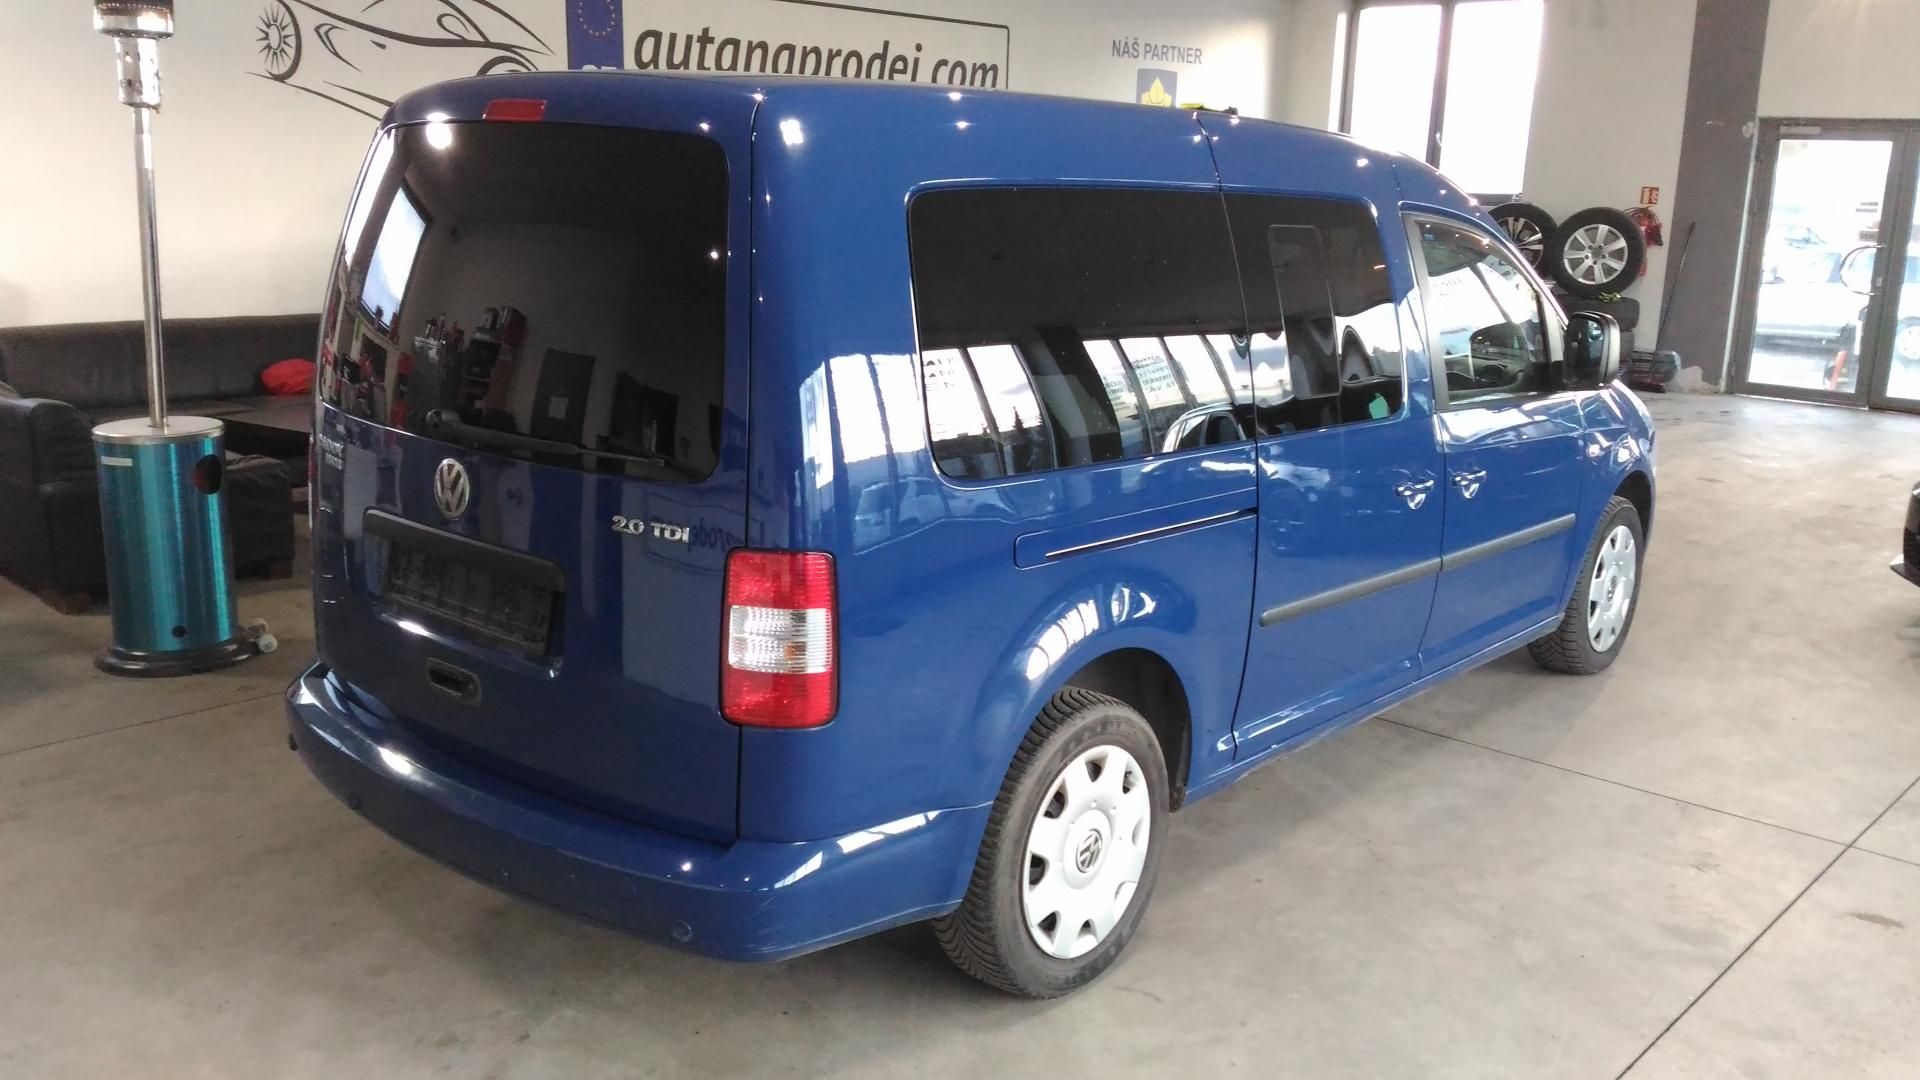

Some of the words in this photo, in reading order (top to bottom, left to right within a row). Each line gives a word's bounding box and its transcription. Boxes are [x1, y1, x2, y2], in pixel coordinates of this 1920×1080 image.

[634, 26, 999, 88] autanaprodejcom
[1111, 37, 1140, 59] NÁŠ
[1143, 42, 1203, 65] PARTNER
[650, 522, 690, 544] TDI
